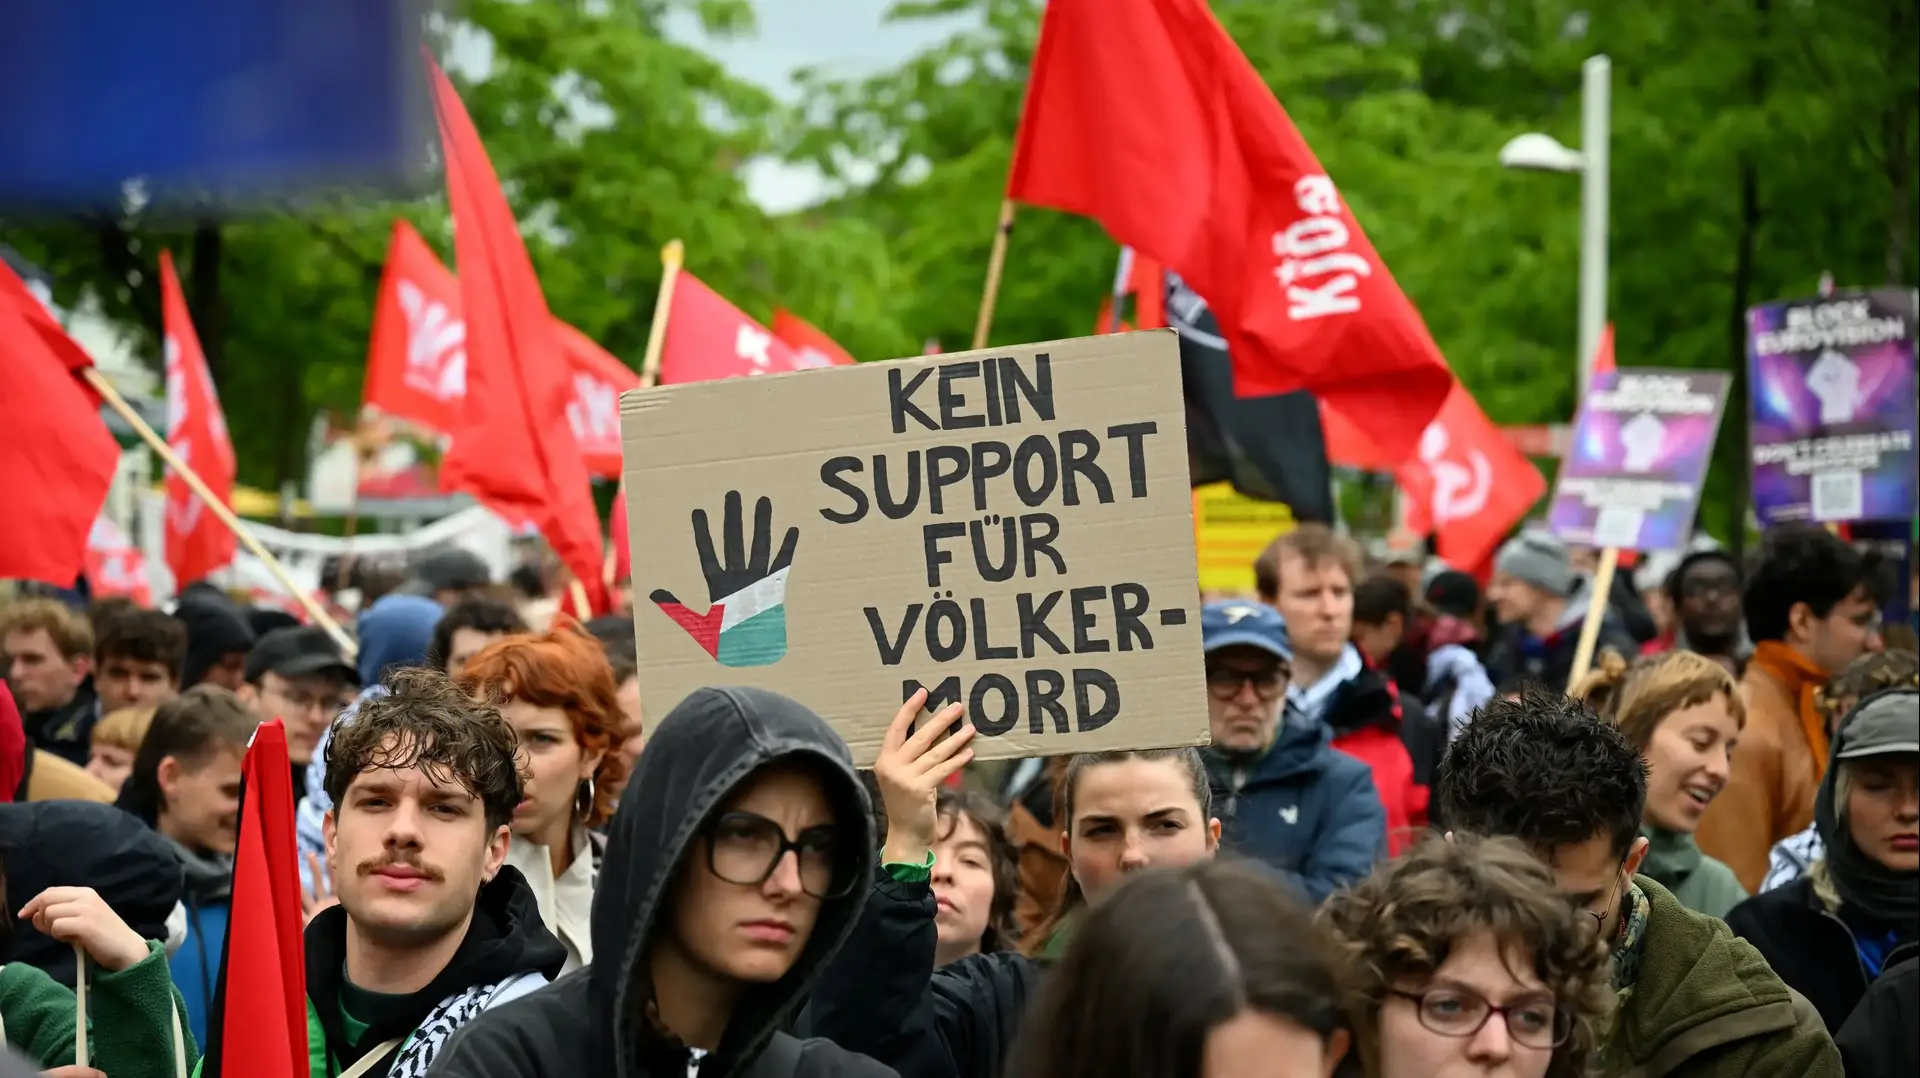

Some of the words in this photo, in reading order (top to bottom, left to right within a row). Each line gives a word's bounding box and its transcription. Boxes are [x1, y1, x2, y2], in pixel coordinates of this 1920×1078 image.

[888, 353, 1056, 434] KEIN
[819, 421, 1157, 524] SUPPORT
[923, 513, 1067, 587] FÜR
[863, 583, 1187, 665] VÖLKER-
[903, 669, 1120, 741] MORD
